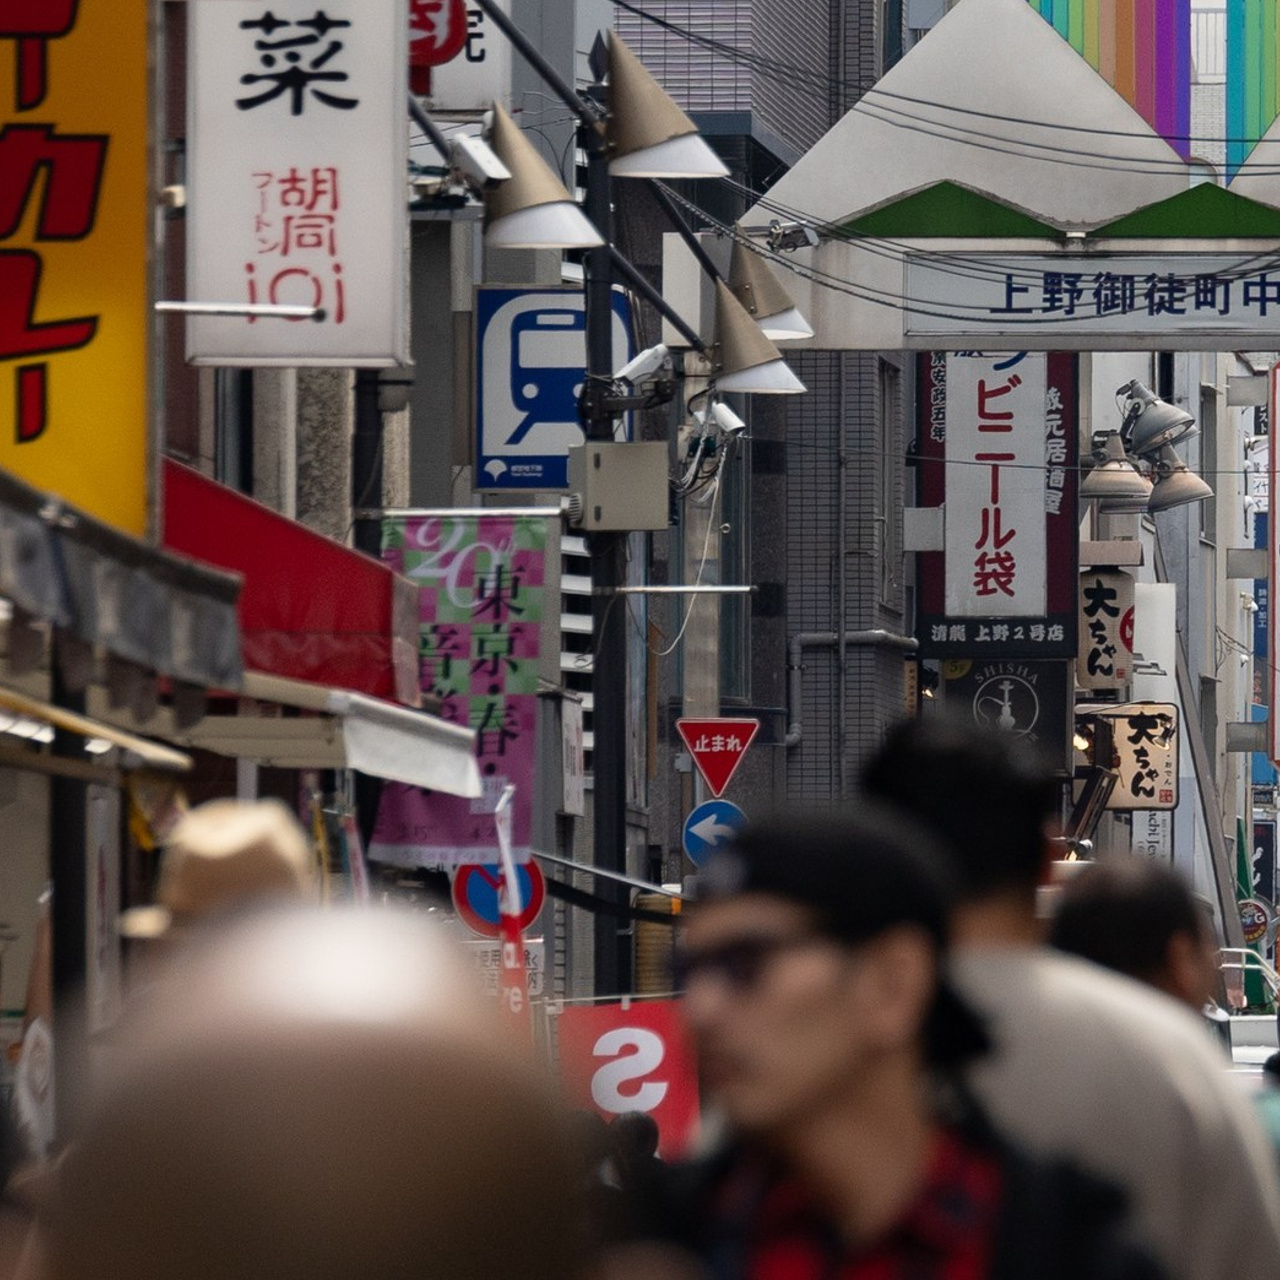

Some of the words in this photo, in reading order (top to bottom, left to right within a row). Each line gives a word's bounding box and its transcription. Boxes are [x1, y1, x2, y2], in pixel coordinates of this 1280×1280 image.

[278, 168, 338, 257] 胡同
[974, 374, 1022, 598] ビニール袋
[1083, 578, 1120, 677] 大ちゃん
[974, 663, 1038, 685] SHISHA
[694, 734, 742, 752] 止まれ
[1127, 711, 1159, 798] 大ちゃん
